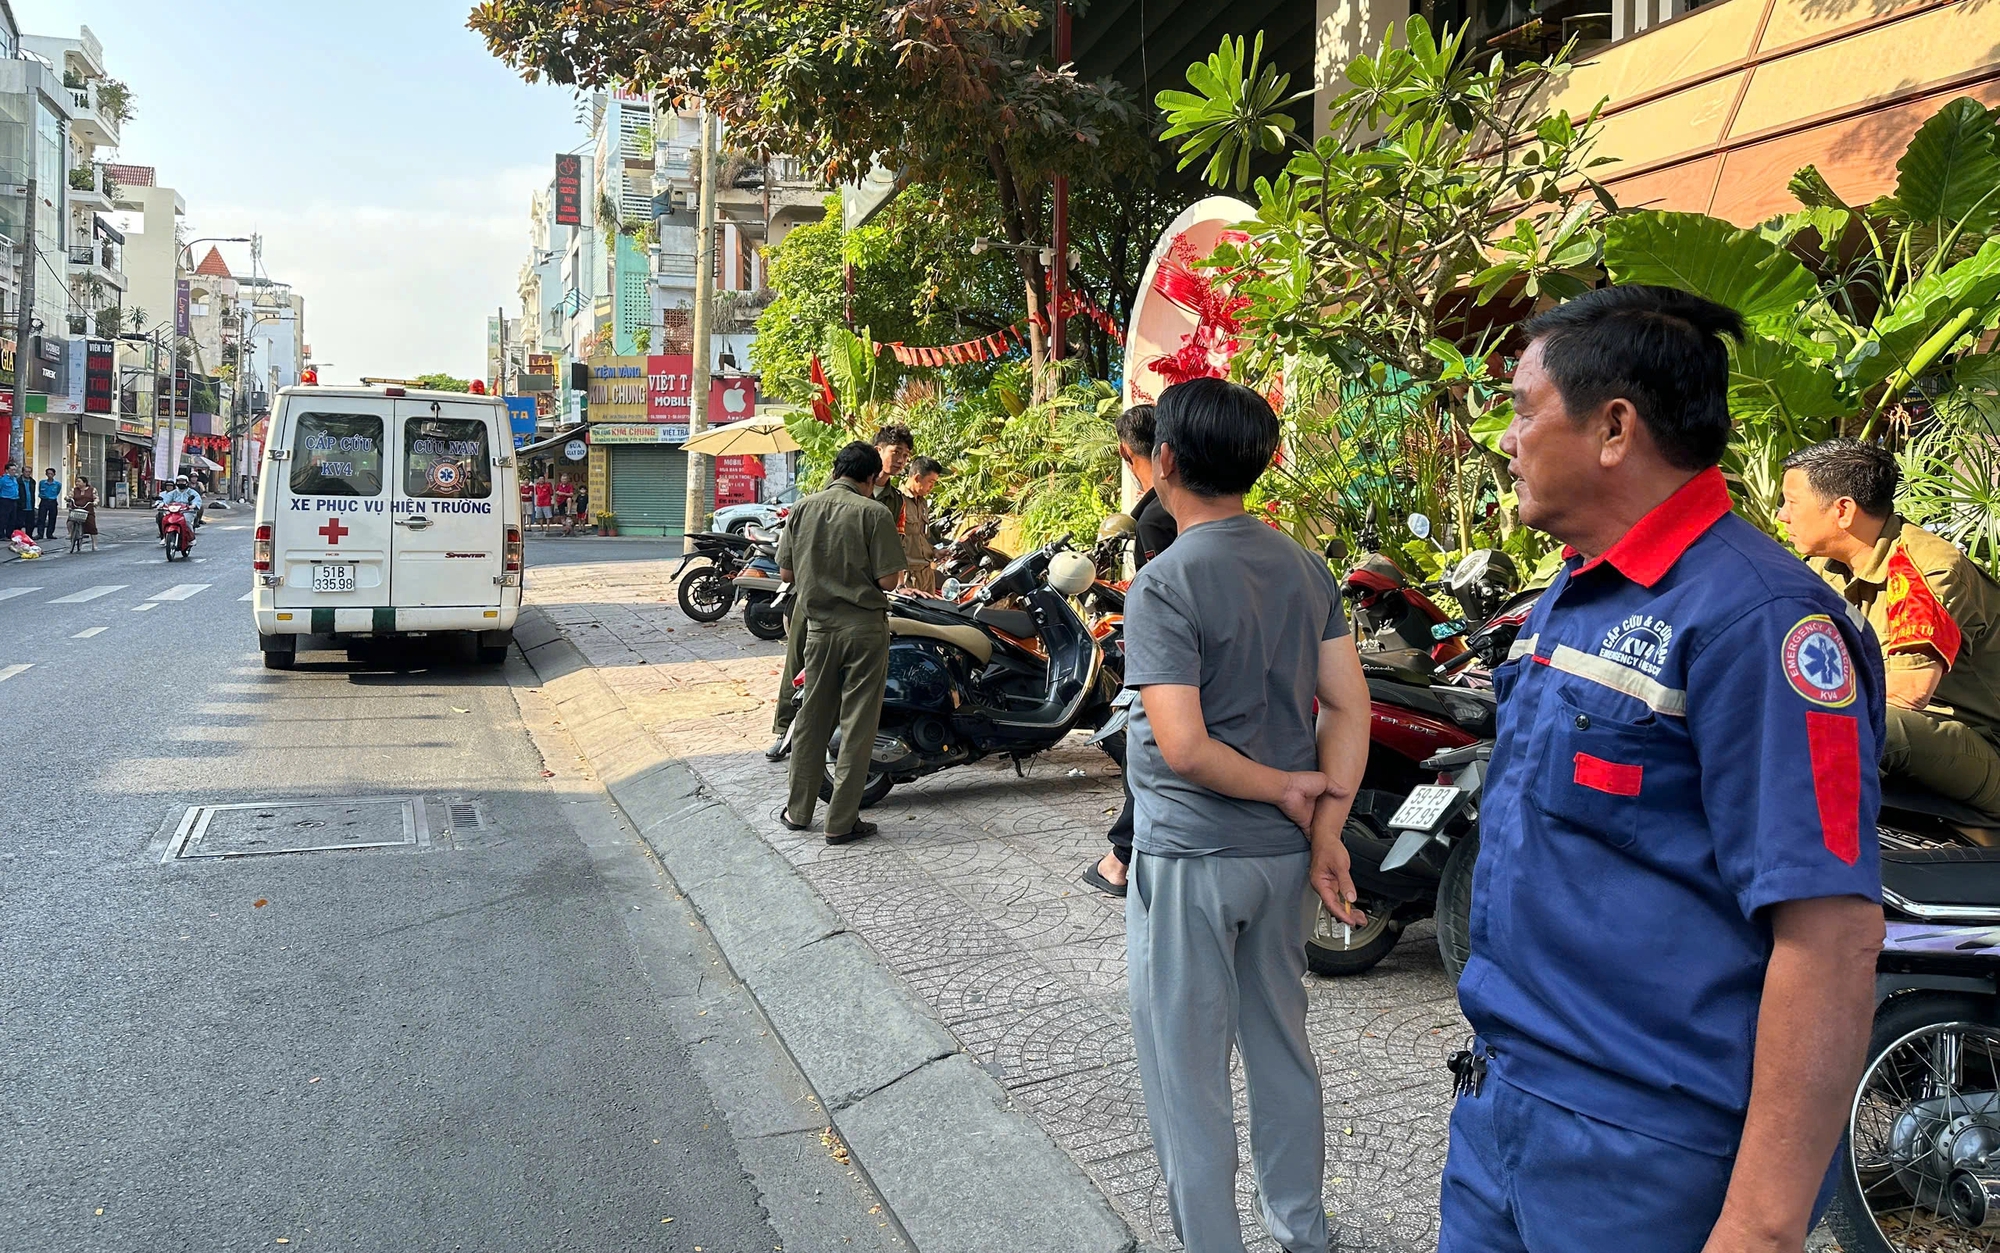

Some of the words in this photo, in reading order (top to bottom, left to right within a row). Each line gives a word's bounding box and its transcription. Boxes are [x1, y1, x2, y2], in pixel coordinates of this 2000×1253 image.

[1, 348, 14, 372] GIA
[42, 367, 56, 379] TREK
[594, 364, 616, 381] TIỆM
[618, 366, 641, 378] VÀNG
[648, 370, 676, 393] VIỆT
[589, 385, 608, 404] KIM
[612, 384, 647, 404] CHUNG
[655, 396, 692, 407] MOBILE
[612, 427, 627, 436] KIM
[629, 428, 656, 436] CHUNG
[662, 428, 676, 437] VIỆT
[305, 430, 337, 450] CẤP
[340, 433, 373, 452] CỨU
[414, 437, 446, 454] CỨU
[449, 440, 480, 457] NẠN
[321, 461, 353, 476] KV4
[724, 458, 744, 466] MOBIL
[290, 499, 311, 511] XE
[316, 499, 358, 515] PHỤC
[364, 500, 384, 516] VỤ
[390, 498, 426, 515] HIỆN
[431, 499, 492, 514] TRƯỜNG
[323, 566, 345, 578] 51B
[314, 578, 353, 590] 335.98
[1643, 615, 1653, 628] &
[1787, 622, 1823, 678] EMERGENCY
[1820, 690, 1838, 700] KV4
[1410, 788, 1451, 806] 59-P3
[1394, 806, 1440, 826] 457.95
